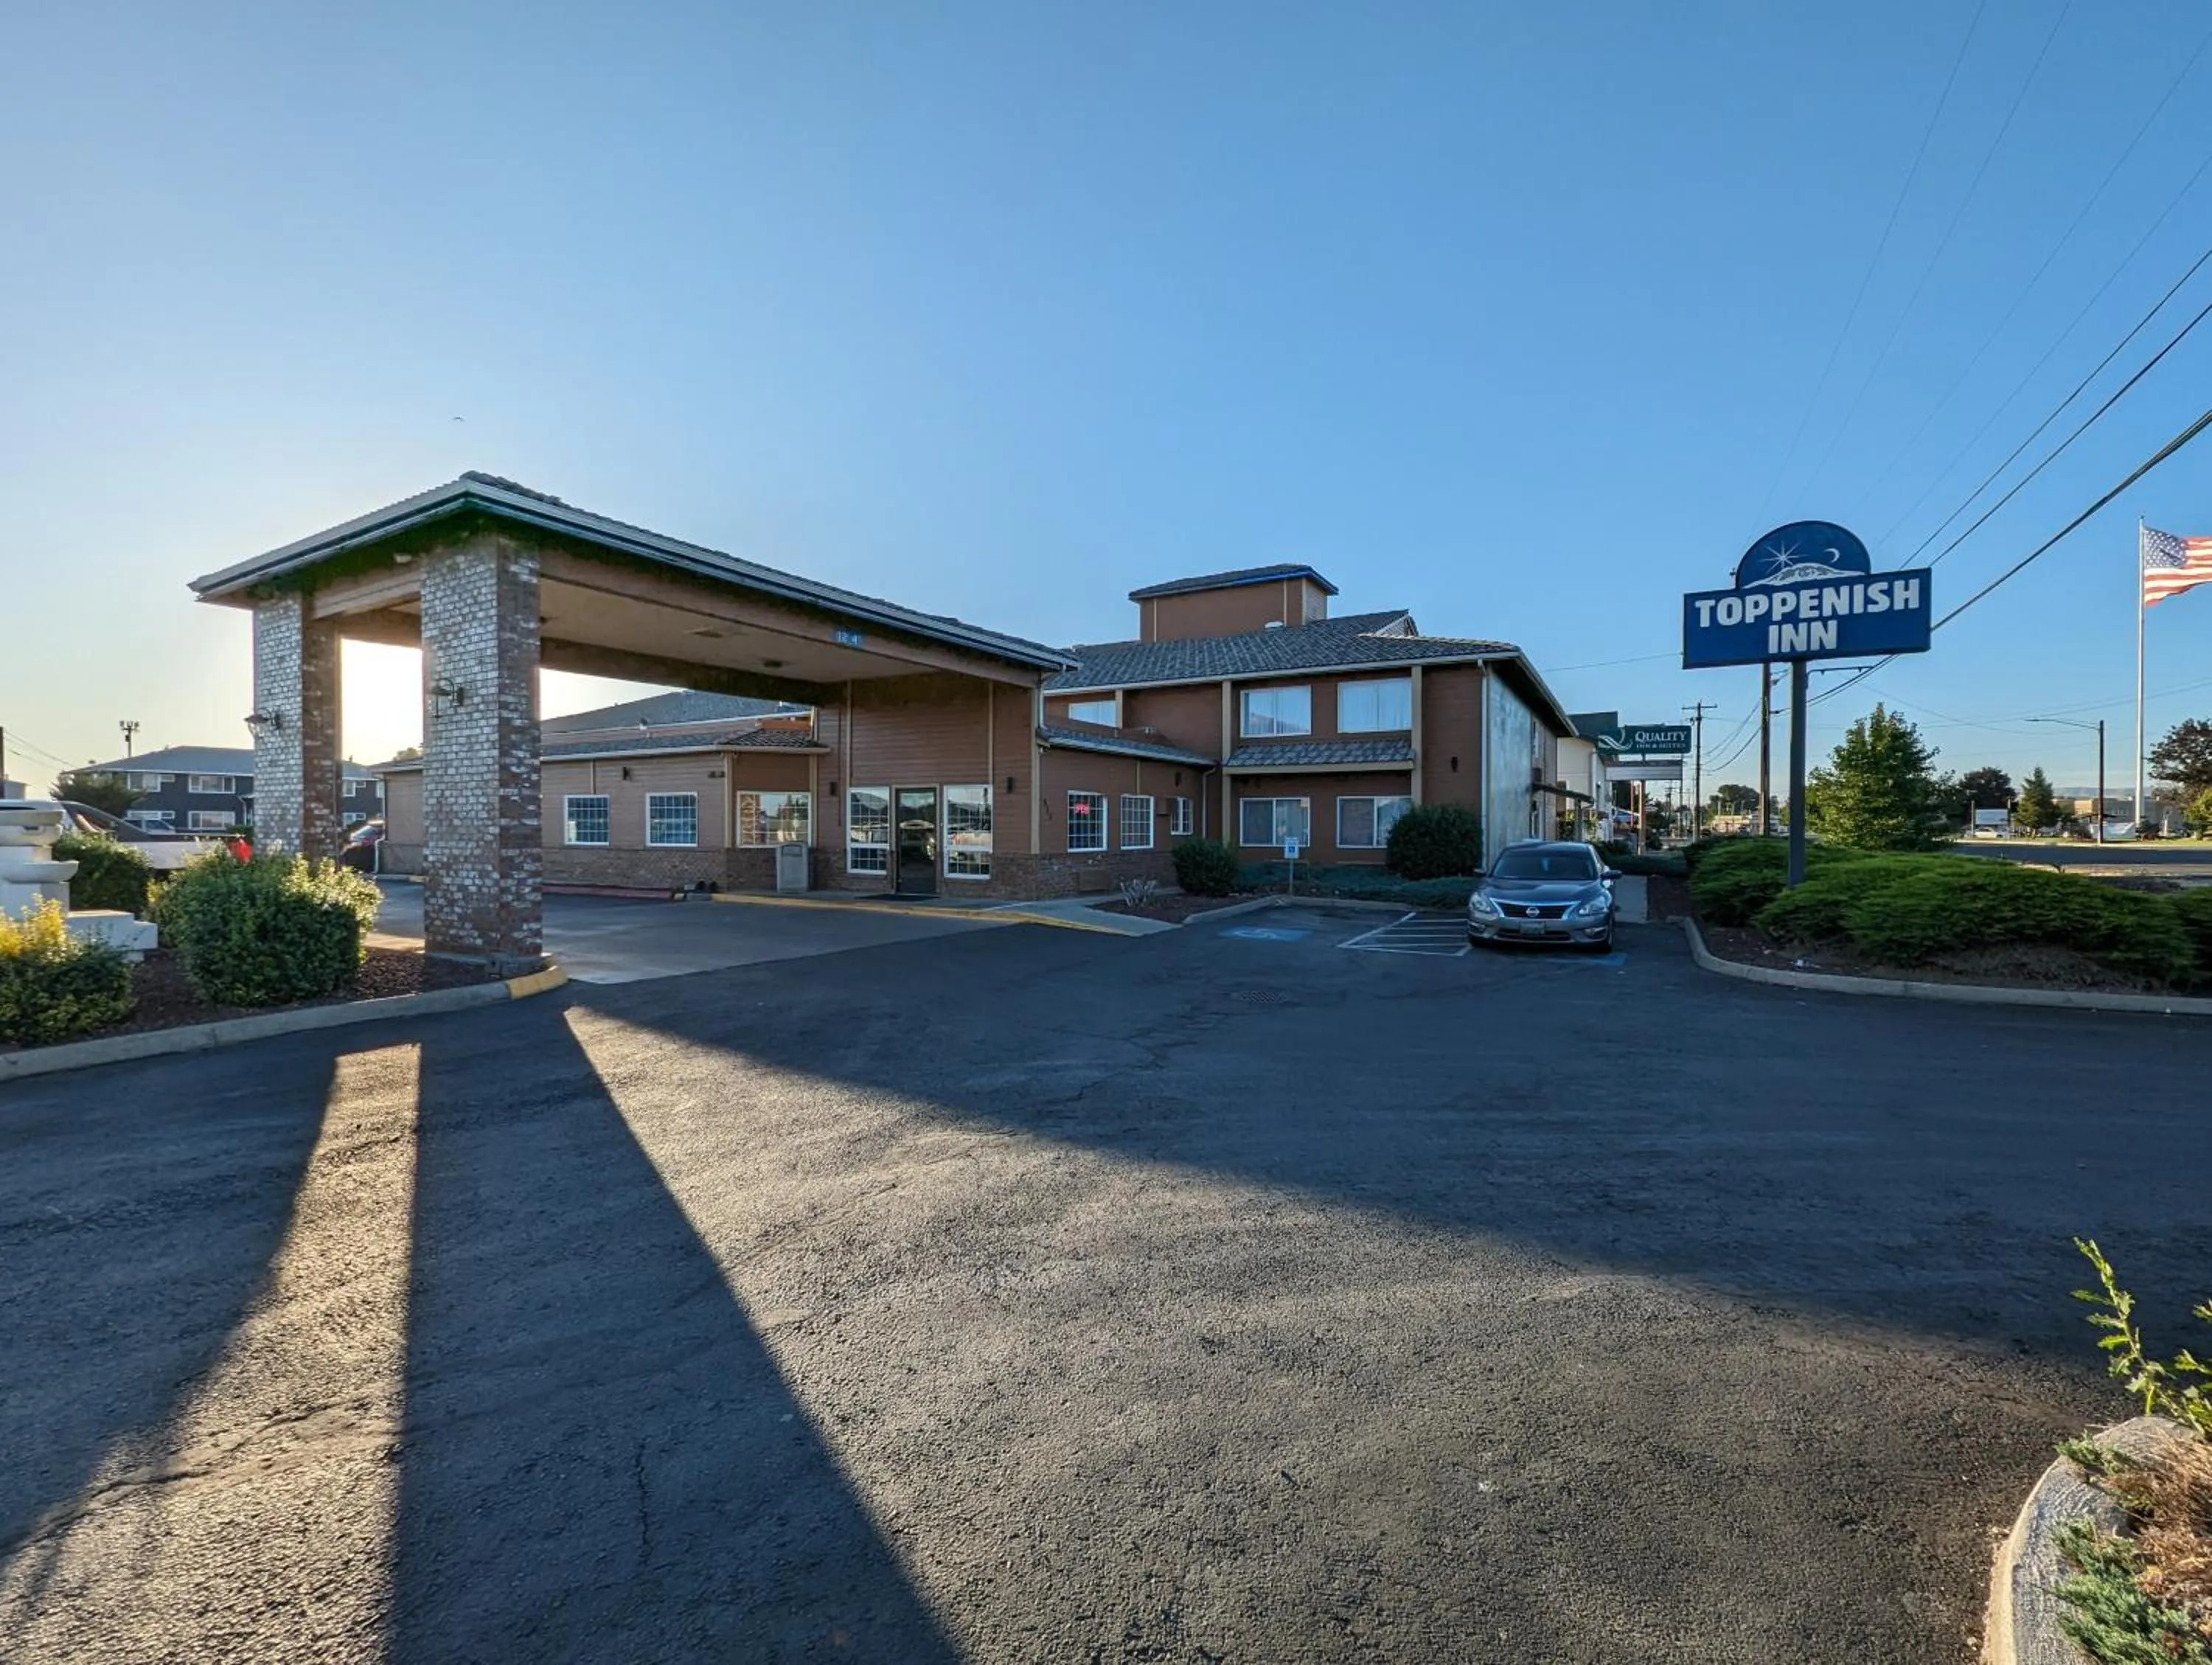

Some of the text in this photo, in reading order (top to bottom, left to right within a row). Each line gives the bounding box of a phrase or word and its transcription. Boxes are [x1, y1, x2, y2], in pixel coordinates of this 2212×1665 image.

[1695, 578, 1920, 628] TOPPENISH
[1769, 620, 1837, 654] INN
[1635, 731, 1687, 743] QUALITY
